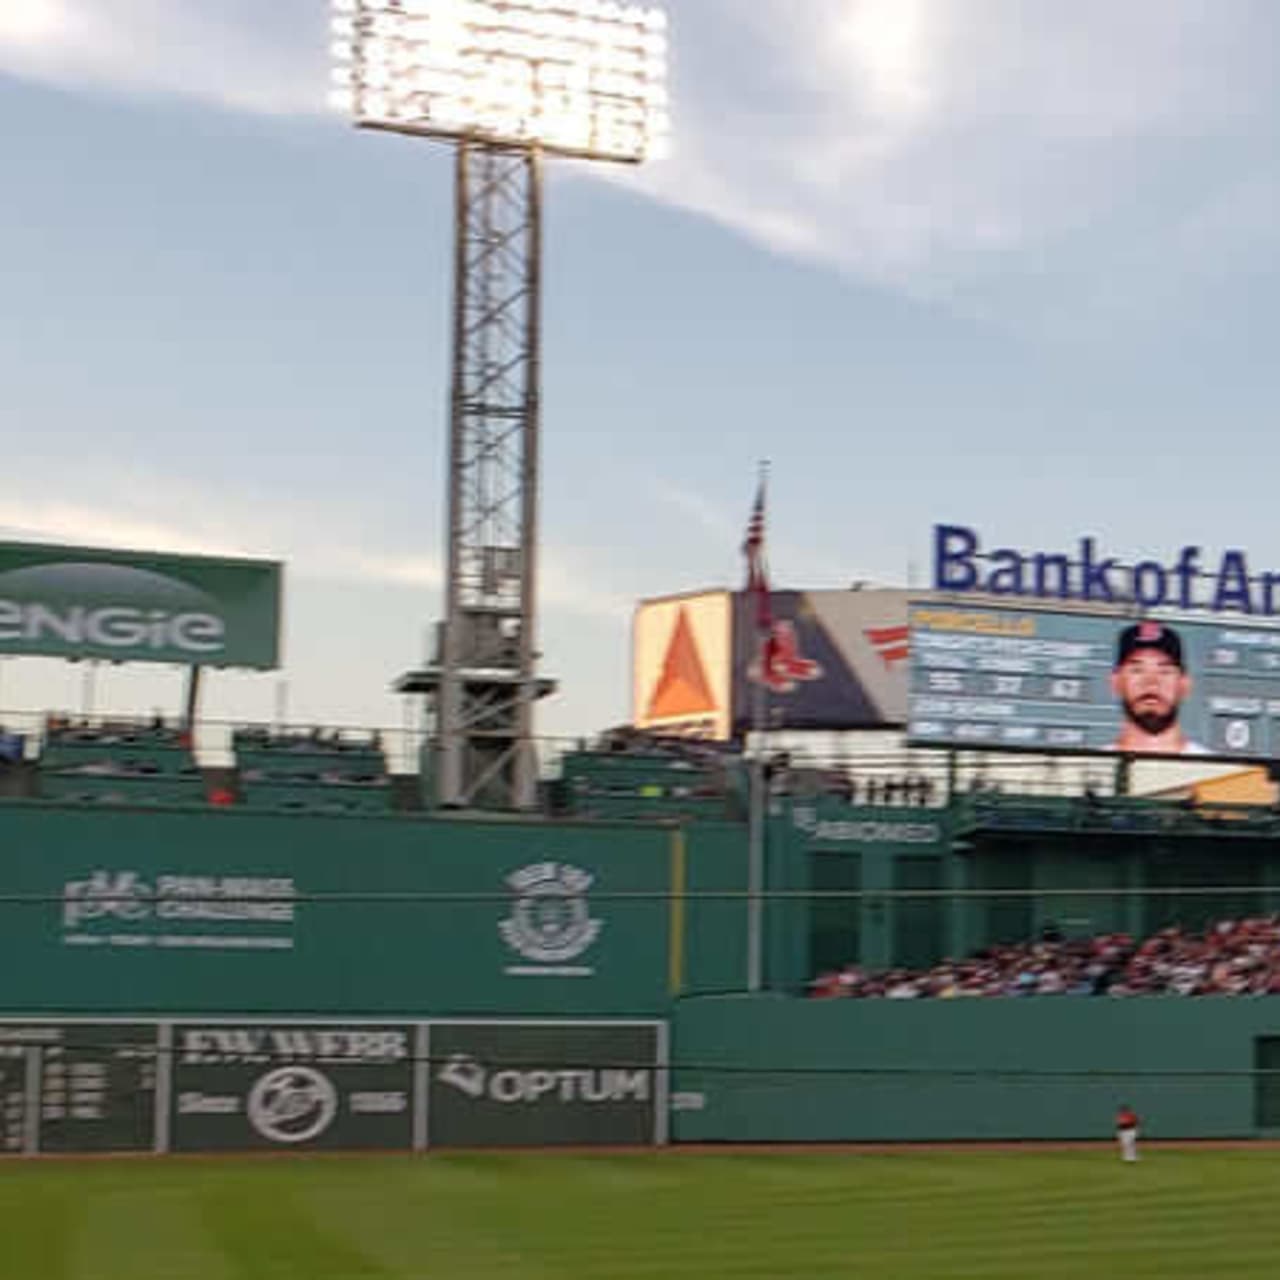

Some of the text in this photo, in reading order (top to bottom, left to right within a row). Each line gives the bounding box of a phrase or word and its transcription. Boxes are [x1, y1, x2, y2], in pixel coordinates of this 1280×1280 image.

[932, 523, 1117, 602] Bank
[1132, 545, 1203, 608] of
[1225, 719, 1250, 750] 0
[489, 1069, 649, 1102] OPTUM
